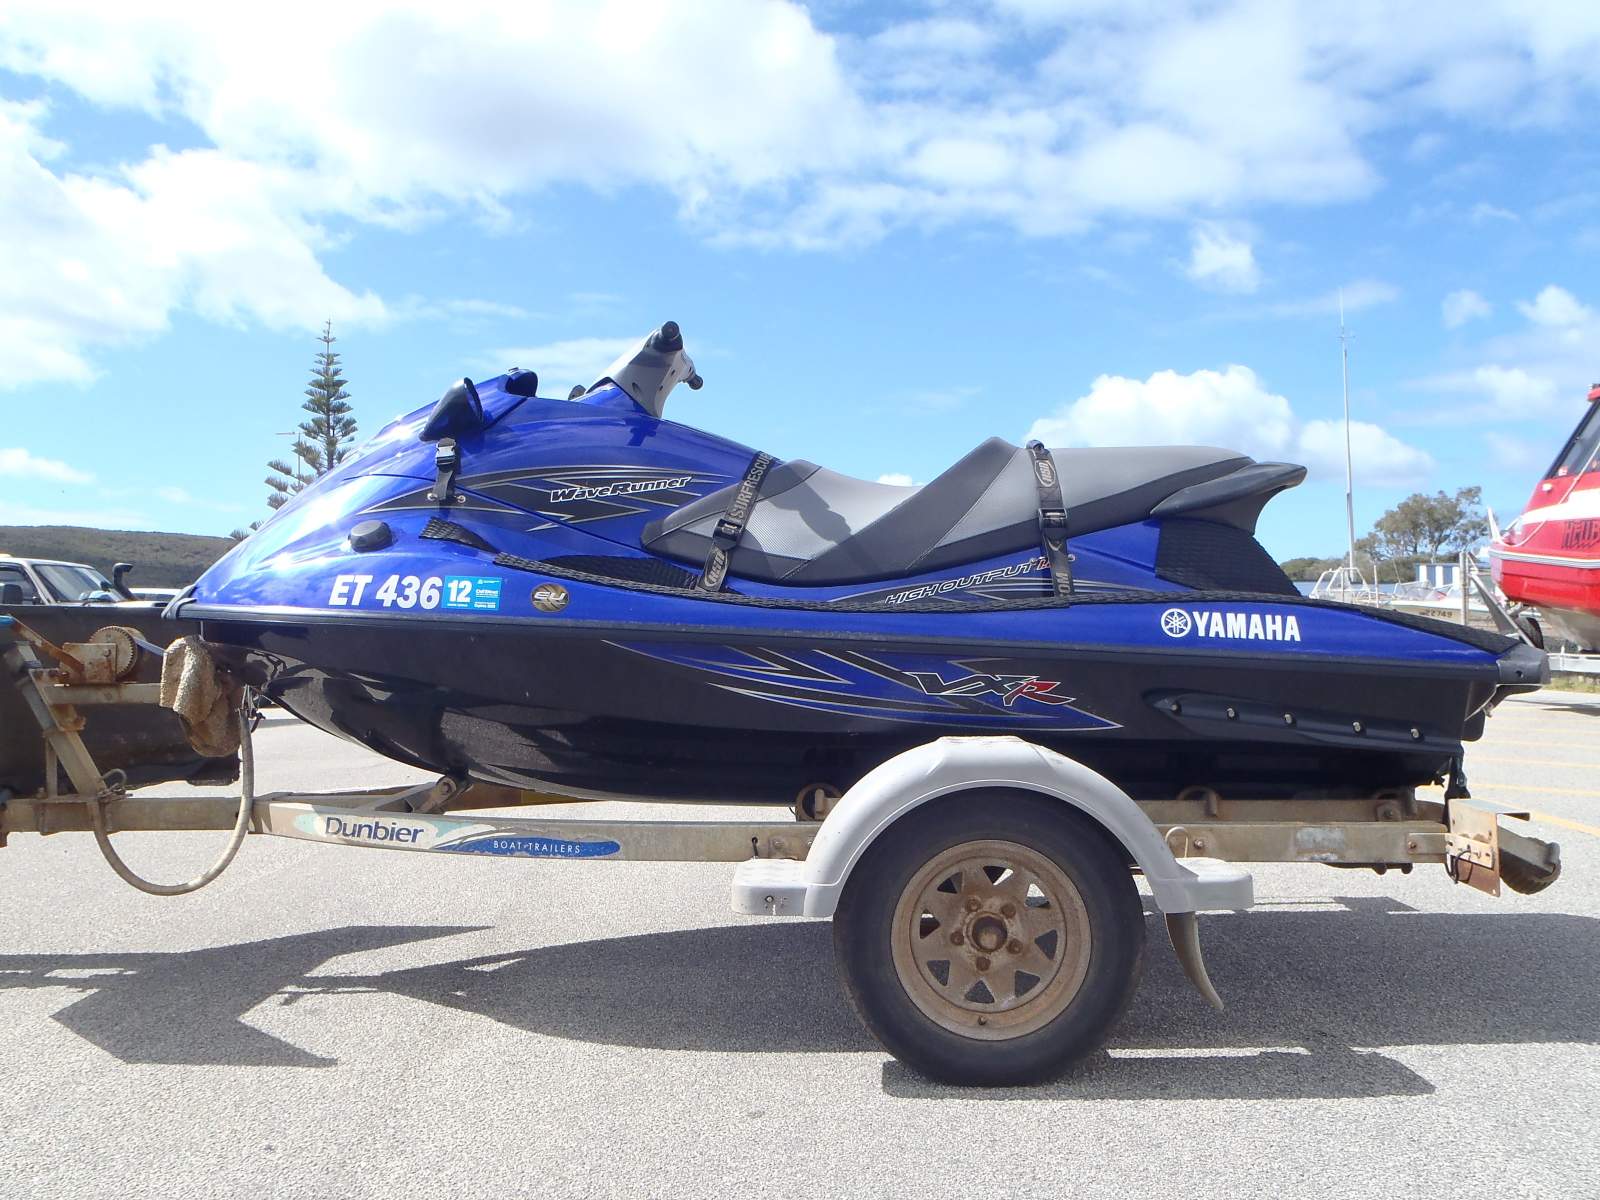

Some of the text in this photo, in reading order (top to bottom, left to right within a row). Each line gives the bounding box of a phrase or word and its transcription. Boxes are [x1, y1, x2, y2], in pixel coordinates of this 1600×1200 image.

[550, 476, 692, 503] WaveRunner
[328, 574, 443, 610] ET 436
[447, 580, 473, 603] 12
[885, 583, 938, 605] HIGH
[938, 562, 1033, 593] OUTPUT
[1192, 611, 1301, 641] YAMAHA
[902, 671, 1077, 706] VXR
[325, 816, 424, 843] Dunbier
[493, 840, 581, 854] BOAT TRAILERS
